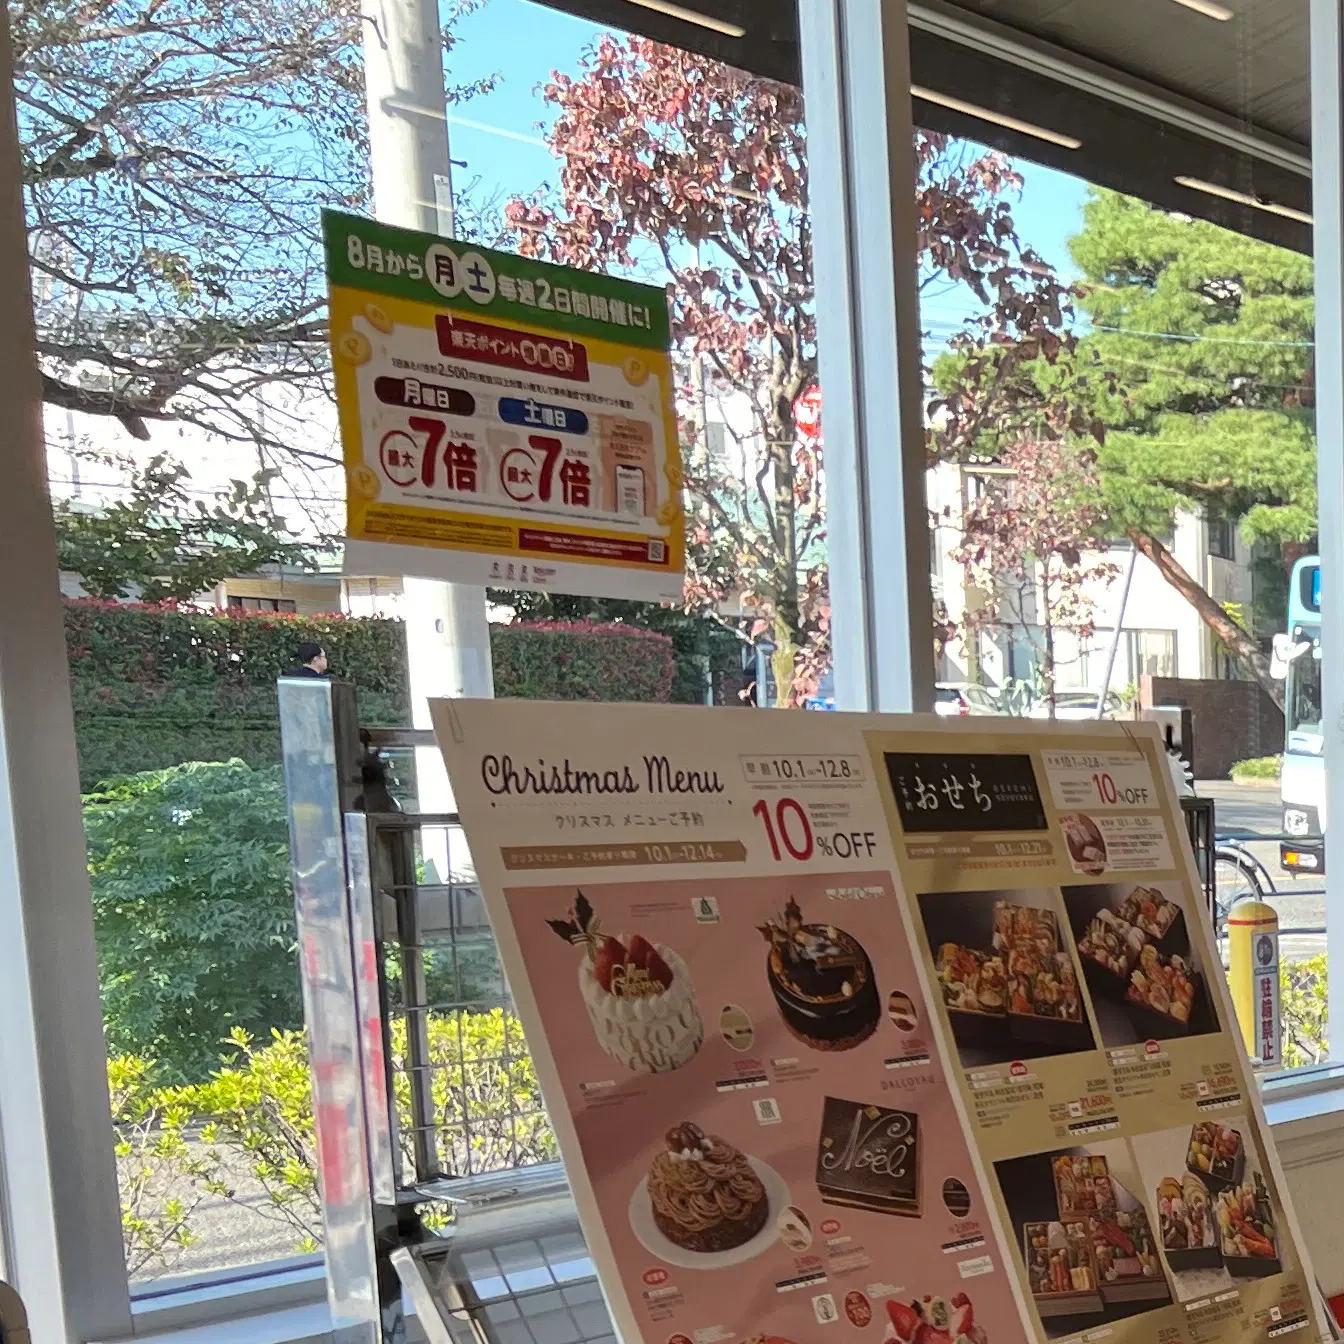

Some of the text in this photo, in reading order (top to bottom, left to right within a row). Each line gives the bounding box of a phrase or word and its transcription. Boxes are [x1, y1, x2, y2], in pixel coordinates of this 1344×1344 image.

[481, 754, 724, 794] Christmas Menu
[914, 773, 992, 812] おせち
[1092, 773, 1117, 804] 10
[556, 814, 615, 829] クリスマス
[752, 797, 814, 862] 10
